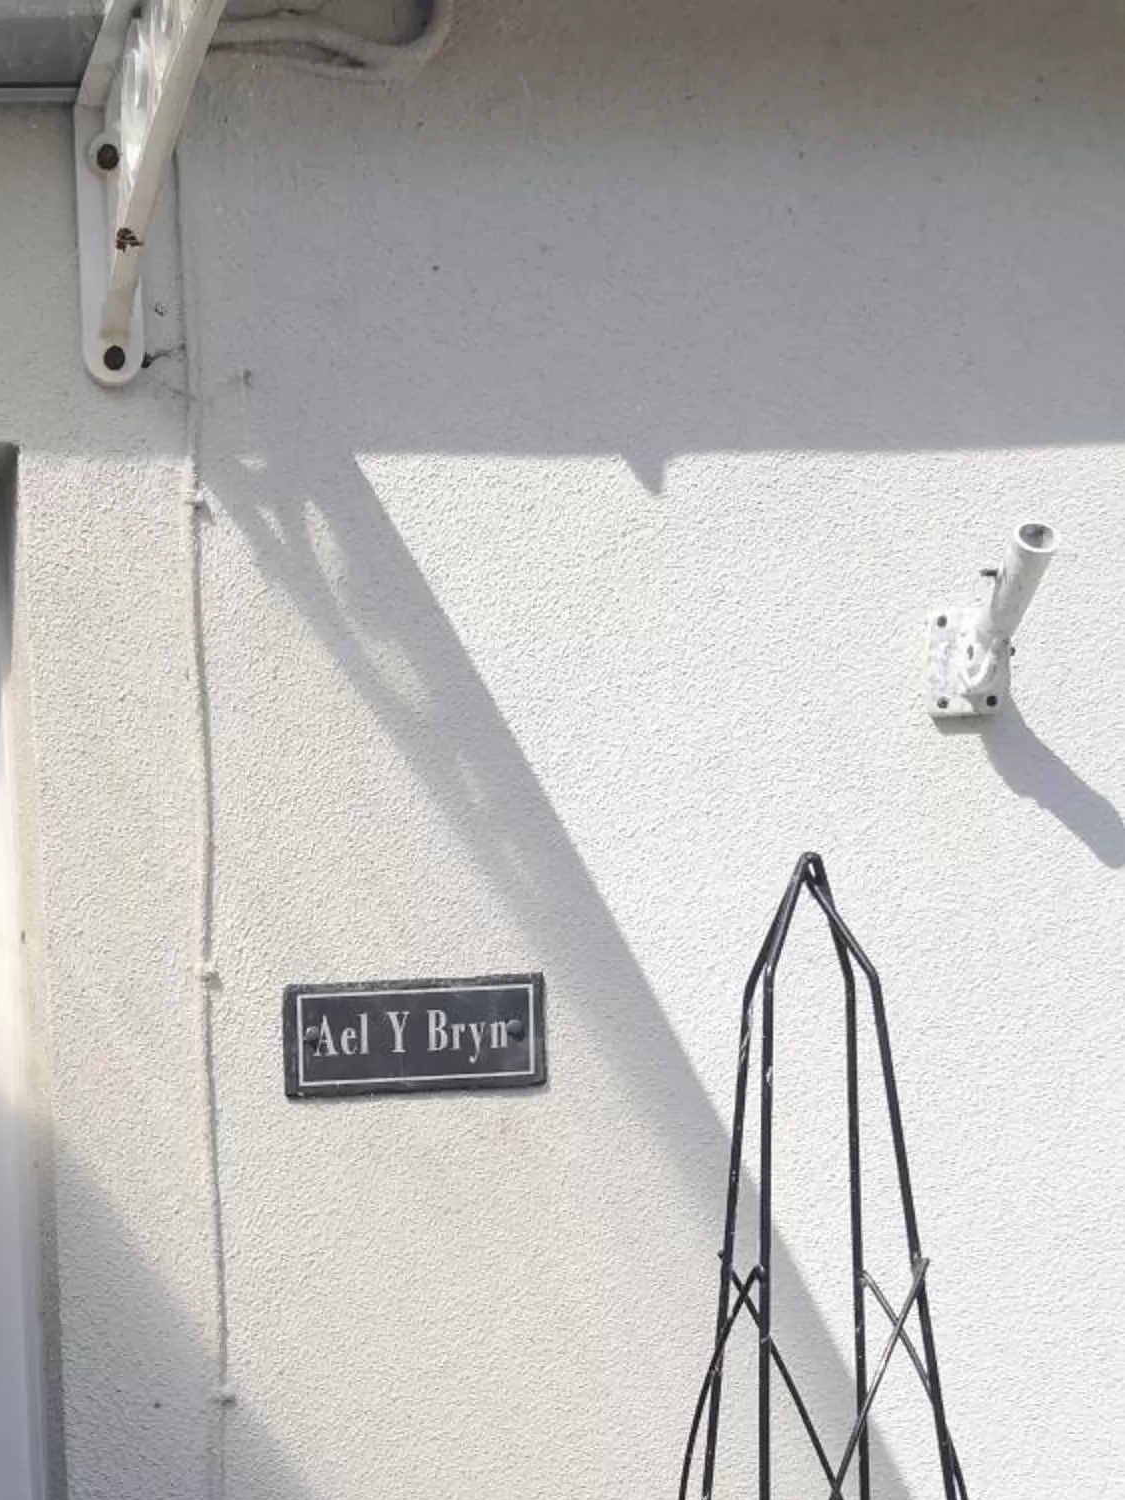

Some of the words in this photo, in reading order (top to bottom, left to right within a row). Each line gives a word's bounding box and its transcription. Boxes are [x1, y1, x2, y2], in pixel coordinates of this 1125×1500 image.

[313, 1012, 370, 1057] Ael
[385, 1011, 410, 1053] Y
[426, 1009, 508, 1064] Bryn
